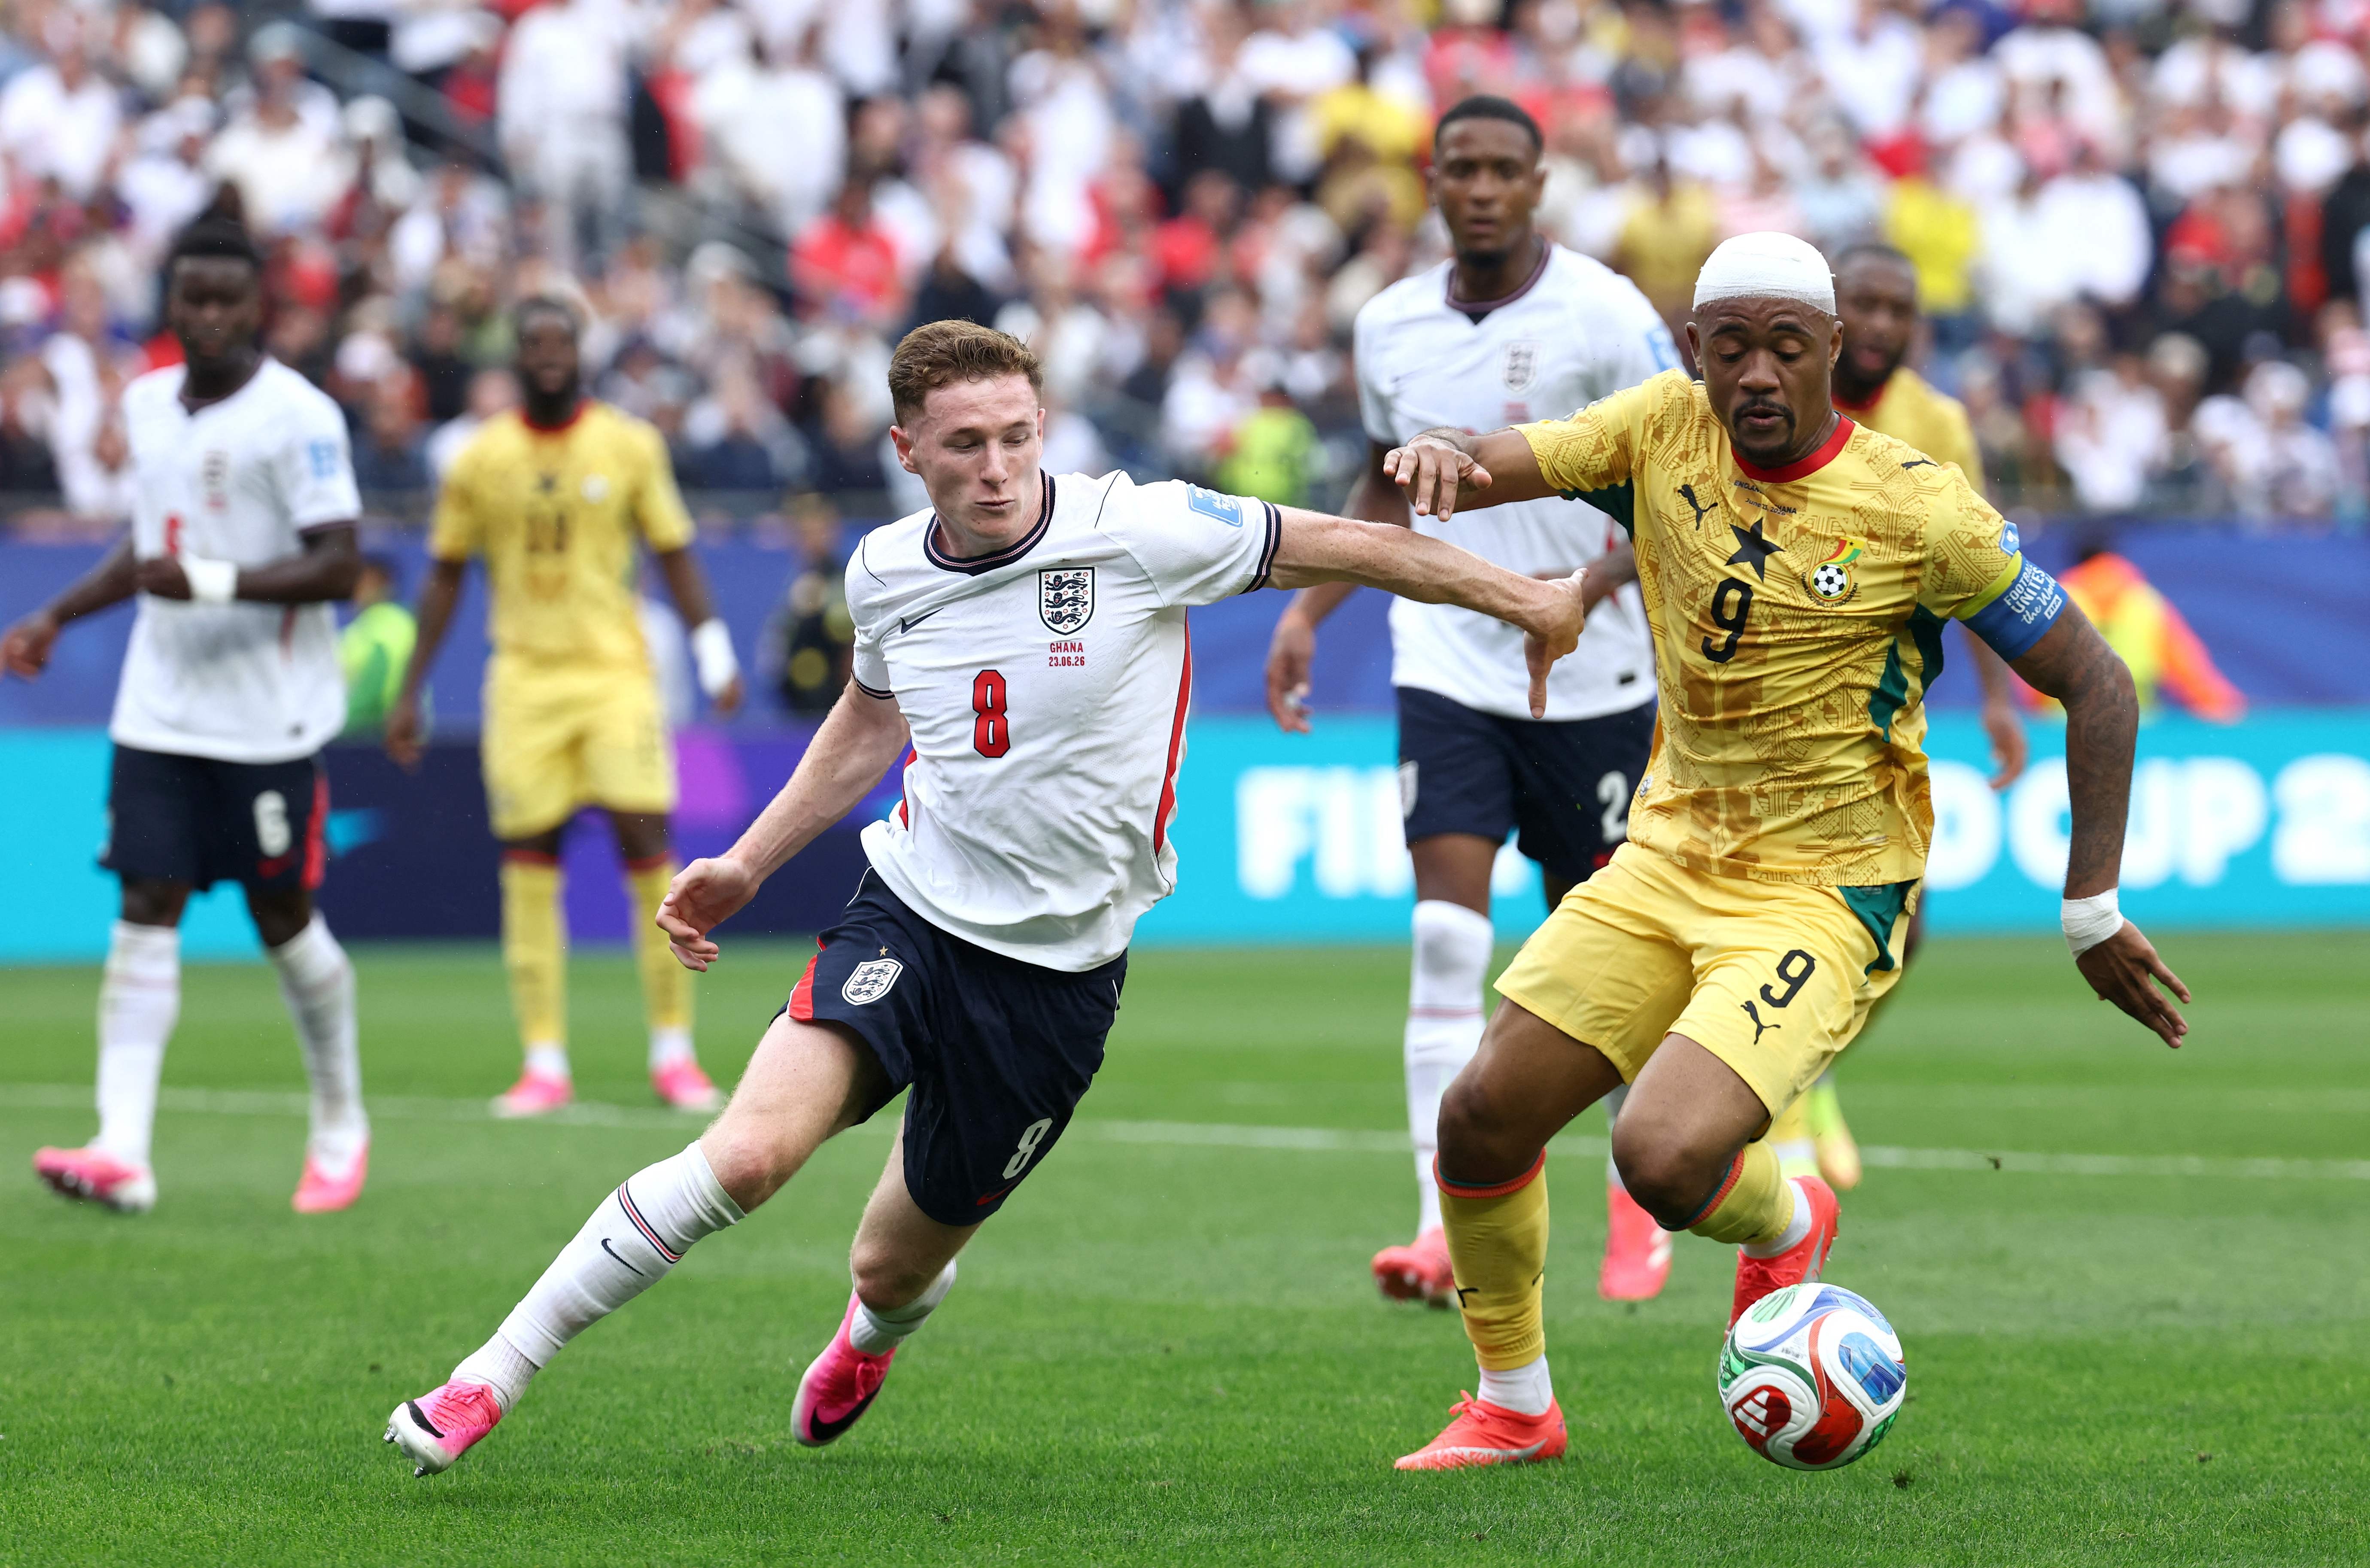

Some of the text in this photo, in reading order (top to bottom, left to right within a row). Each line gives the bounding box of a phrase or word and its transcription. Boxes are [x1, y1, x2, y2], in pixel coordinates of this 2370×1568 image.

[1745, 498, 1761, 508] June
[2011, 567, 2045, 613] UNITES
[1702, 577, 1754, 663] 9
[2021, 605, 2042, 624] the
[1049, 656, 1085, 666] 23.06.26
[1050, 642, 1084, 653] GHANA
[972, 669, 1010, 758] 8
[1759, 949, 1817, 1008] 9
[1002, 1117, 1053, 1179] 8
